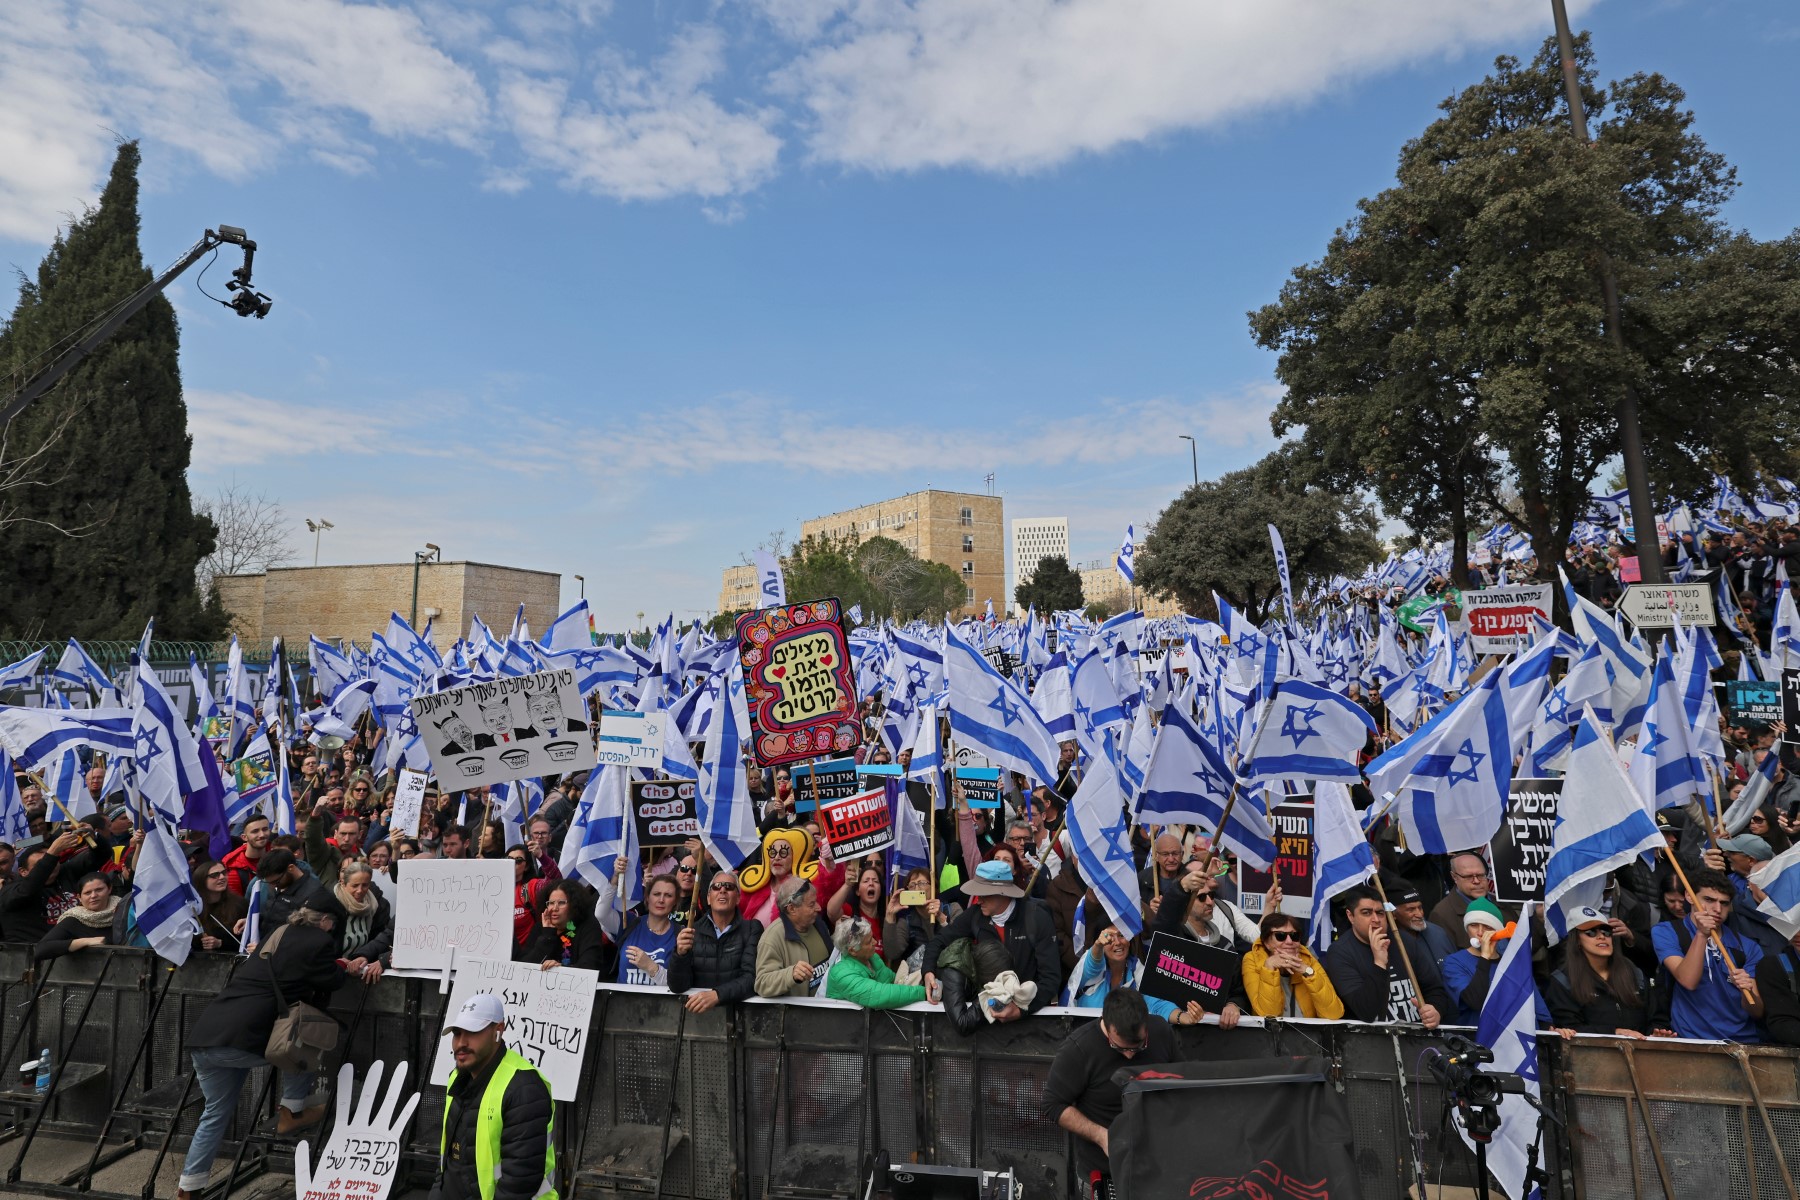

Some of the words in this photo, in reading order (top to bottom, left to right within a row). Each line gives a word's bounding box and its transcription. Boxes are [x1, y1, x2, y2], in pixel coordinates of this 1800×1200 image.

[1640, 590, 1669, 599] האוצר
[1672, 589, 1699, 598] משרד
[1645, 602, 1668, 612] لمالية
[1478, 614, 1498, 632] בך!
[1637, 614, 1668, 623] Ministry
[773, 638, 830, 665] מצילים
[791, 658, 819, 676] את
[558, 669, 573, 688] לא
[449, 690, 463, 707] על
[465, 684, 497, 703] לשמור
[778, 687, 837, 719] קרטיה
[1737, 711, 1778, 720] המשטרית
[598, 751, 631, 764] מהפסים
[629, 745, 659, 758] ירדנו
[465, 764, 483, 773] אוצר
[803, 773, 835, 786] חופש
[836, 771, 854, 786] אין
[644, 787, 670, 797] The
[680, 785, 695, 796] wh
[800, 788, 835, 800] הייטק
[836, 785, 854, 800] אין
[982, 791, 995, 799] אין
[641, 803, 683, 815] world
[831, 793, 888, 822] מושחתים
[651, 821, 698, 833] watchi
[1280, 837, 1308, 856] היא
[423, 899, 468, 917] מוצדק
[482, 900, 500, 917] לא
[441, 921, 499, 955] למען
[1157, 954, 1223, 990] שובתות
[502, 987, 529, 1007] אבל
[1209, 989, 1219, 997] לא
[521, 1017, 582, 1054] מפסידה
[344, 1138, 398, 1159] תידברו
[326, 1150, 346, 1170] שלי
[350, 1156, 371, 1172] היד
[372, 1160, 395, 1176] עם
[327, 1177, 342, 1190] לא
[344, 1179, 382, 1193] עבריינים
